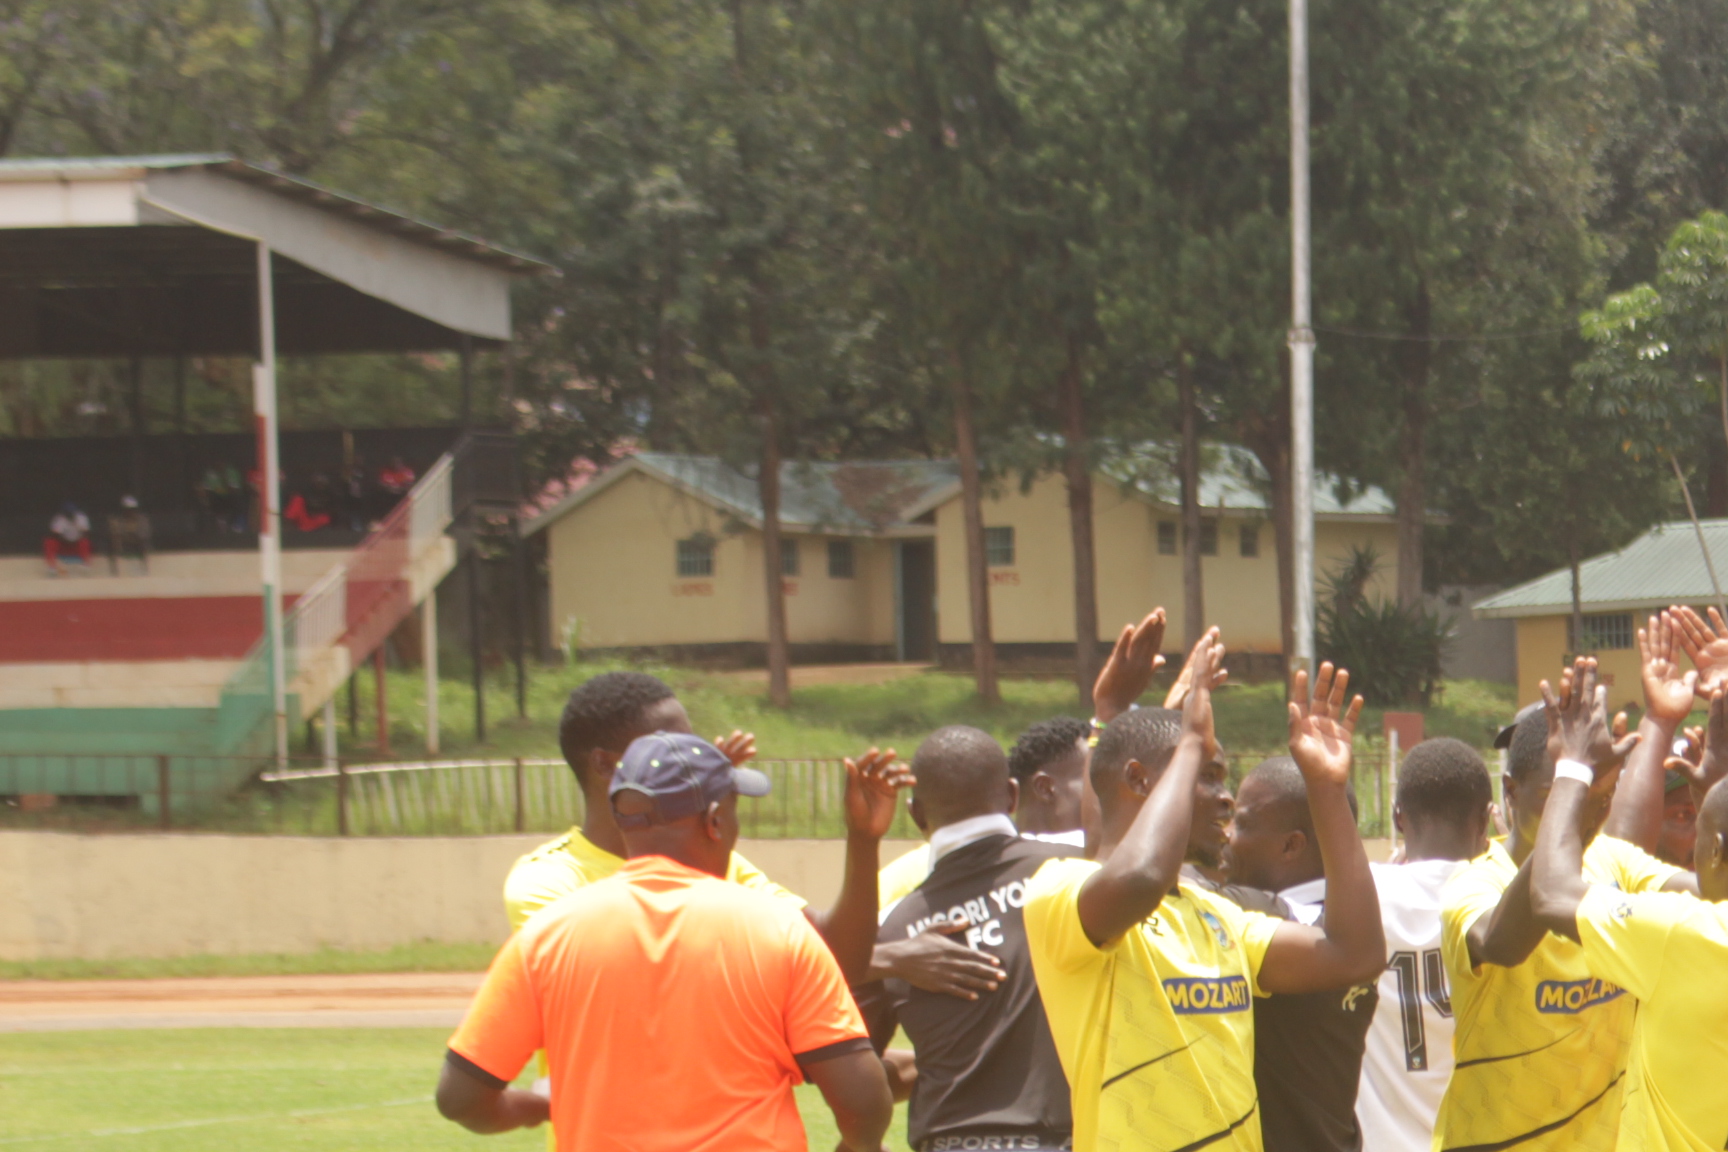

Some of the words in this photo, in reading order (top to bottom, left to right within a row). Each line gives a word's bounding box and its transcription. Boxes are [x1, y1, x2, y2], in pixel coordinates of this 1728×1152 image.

[989, 877, 1031, 913] YO
[965, 919, 1004, 951] FC
[1165, 980, 1247, 1010] MOZART
[932, 1134, 1040, 1152] SPORTS
